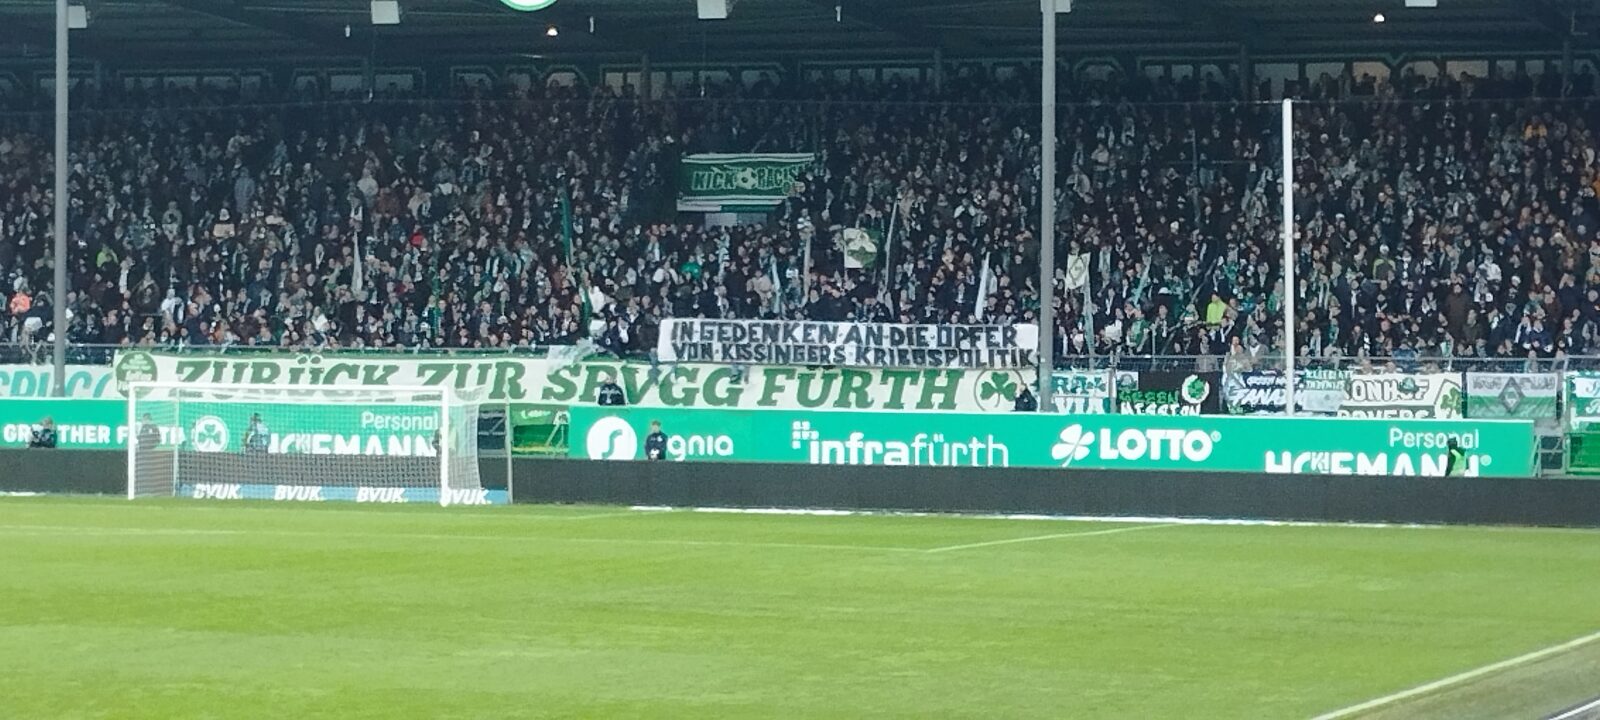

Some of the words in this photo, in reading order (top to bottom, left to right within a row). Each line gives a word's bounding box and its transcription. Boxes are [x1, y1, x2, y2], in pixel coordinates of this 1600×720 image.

[691, 169, 737, 190] KICK
[671, 321, 694, 344] IN
[936, 326, 1018, 349] OPFER
[672, 343, 714, 361] VON
[170, 355, 400, 400] ZURÜCK
[412, 361, 528, 400] ZUR
[757, 367, 965, 408] FÜRTH
[361, 411, 438, 431] Personal
[808, 431, 1009, 467] infrafürth
